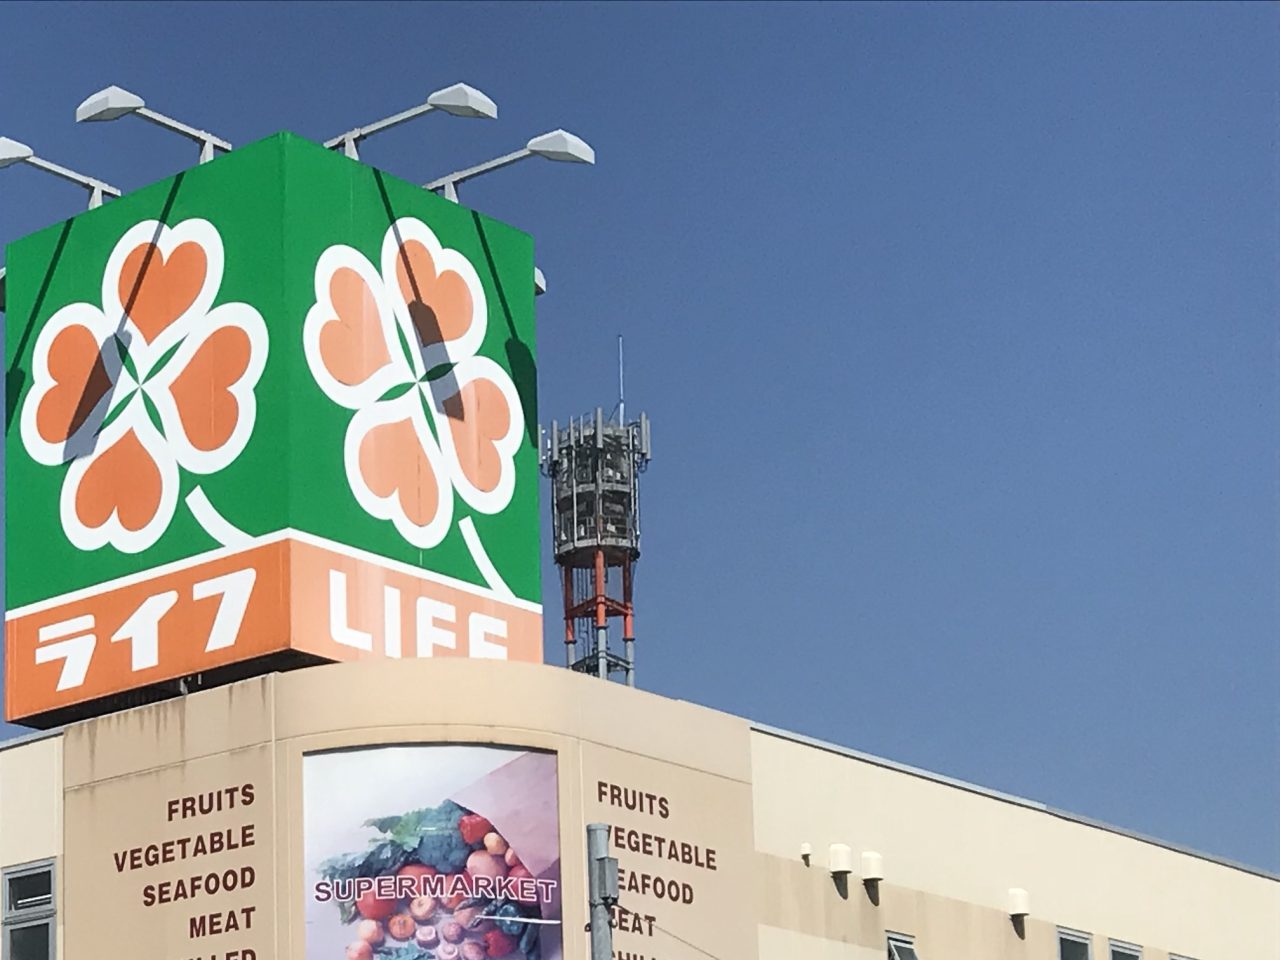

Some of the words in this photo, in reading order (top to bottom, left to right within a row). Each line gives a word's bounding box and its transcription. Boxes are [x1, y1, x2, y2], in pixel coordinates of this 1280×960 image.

[34, 567, 257, 693] ライフ
[329, 569, 508, 660] LIFE
[166, 783, 256, 822] FRUITS
[597, 780, 670, 819] FRUITS
[113, 824, 256, 873] VEGETABLE
[607, 824, 718, 871] EGETABLE
[142, 866, 256, 907] SEAFOOD
[313, 873, 559, 903] SUPERMARKET
[617, 868, 694, 905] EAFOOD
[188, 906, 257, 939] MEAT
[610, 907, 657, 937] EAT
